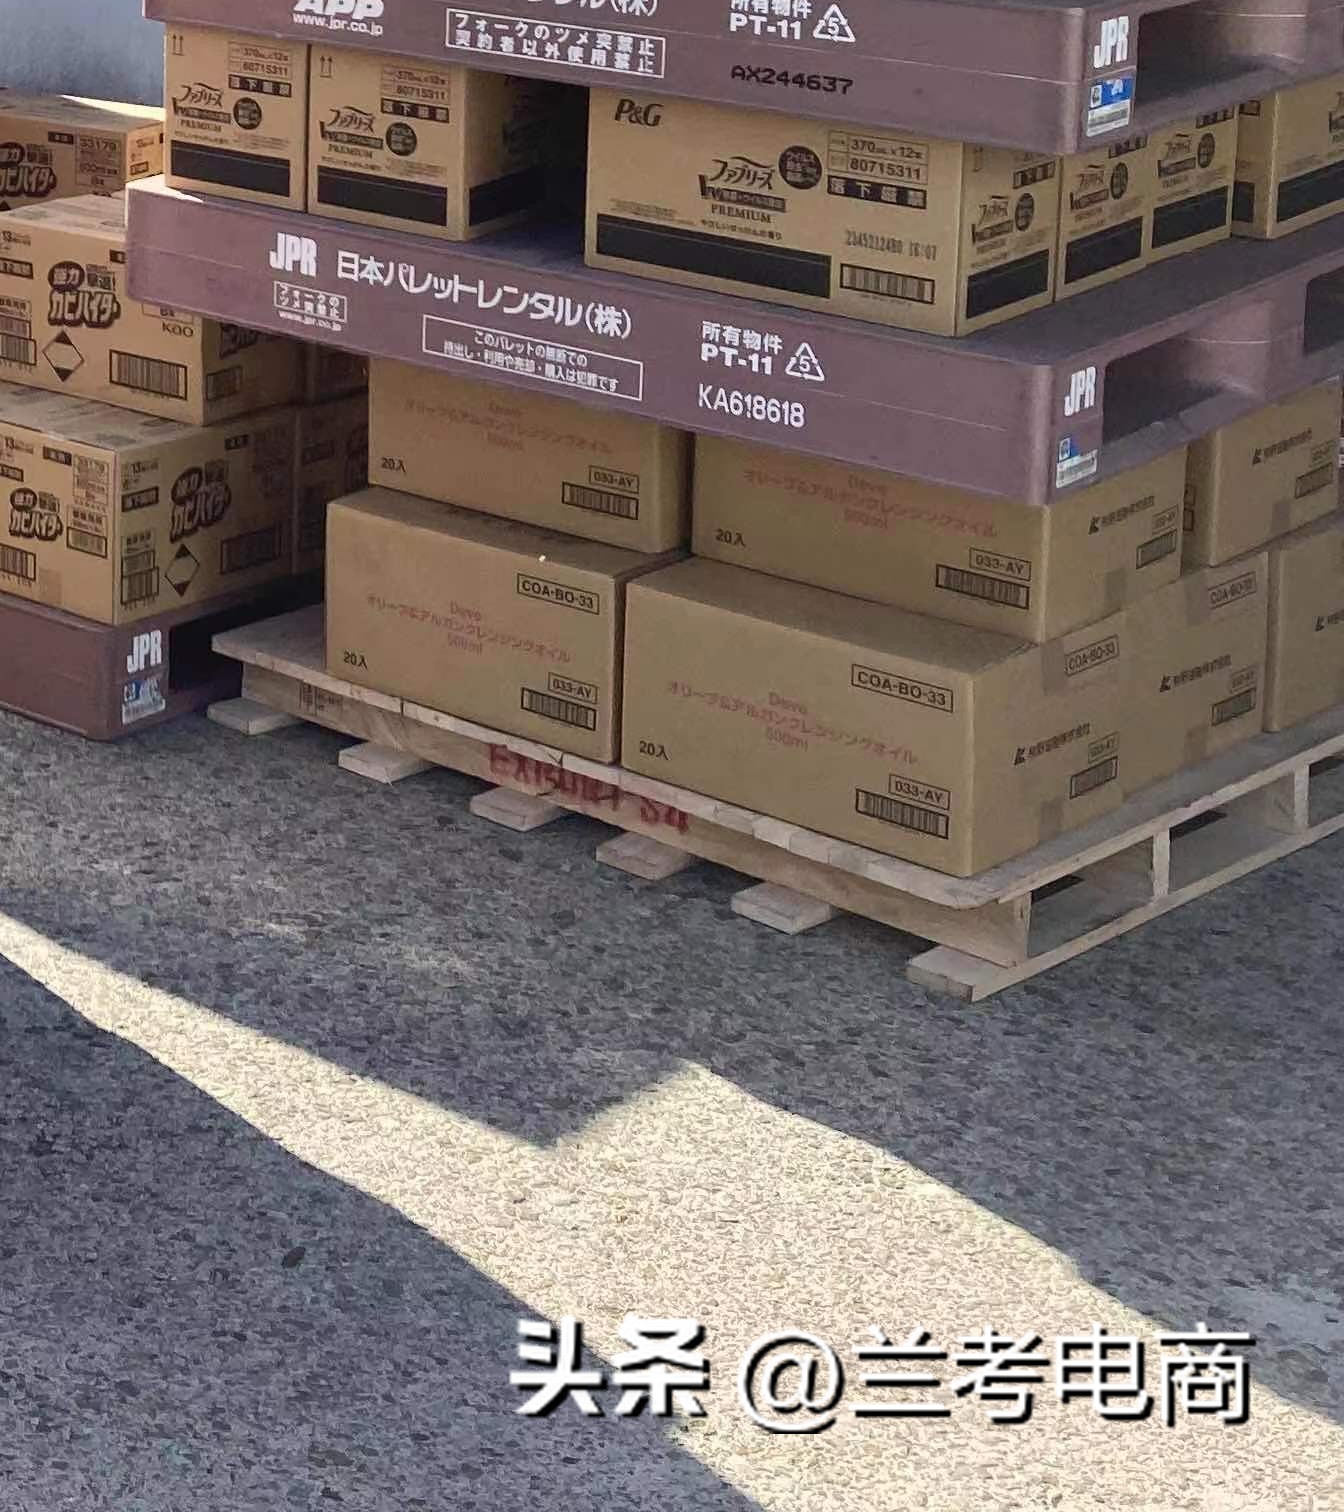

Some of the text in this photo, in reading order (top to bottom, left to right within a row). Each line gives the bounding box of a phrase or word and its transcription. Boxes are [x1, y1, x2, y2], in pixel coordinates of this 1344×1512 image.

[293, 13, 383, 36] www.jpr.co.jp
[730, 13, 802, 41] PT-11
[1094, 16, 1129, 68] JPR
[731, 66, 854, 95] AX244637
[614, 98, 664, 127] P&G
[850, 158, 921, 181] 80715311
[711, 204, 772, 225] PREMIUM
[270, 232, 632, 338] JPR 日本パレットレンタル(株)
[702, 320, 783, 356] 所有物件
[700, 344, 774, 375] PT-11
[697, 384, 806, 428] KA618618
[1064, 366, 1097, 417] JPR
[520, 579, 594, 610] COA-BO-33
[127, 630, 162, 673] JPR
[342, 650, 368, 670] 20入
[856, 669, 948, 708] COA-BO-33
[639, 740, 670, 761] 20入
[894, 779, 946, 803] 033-AY
